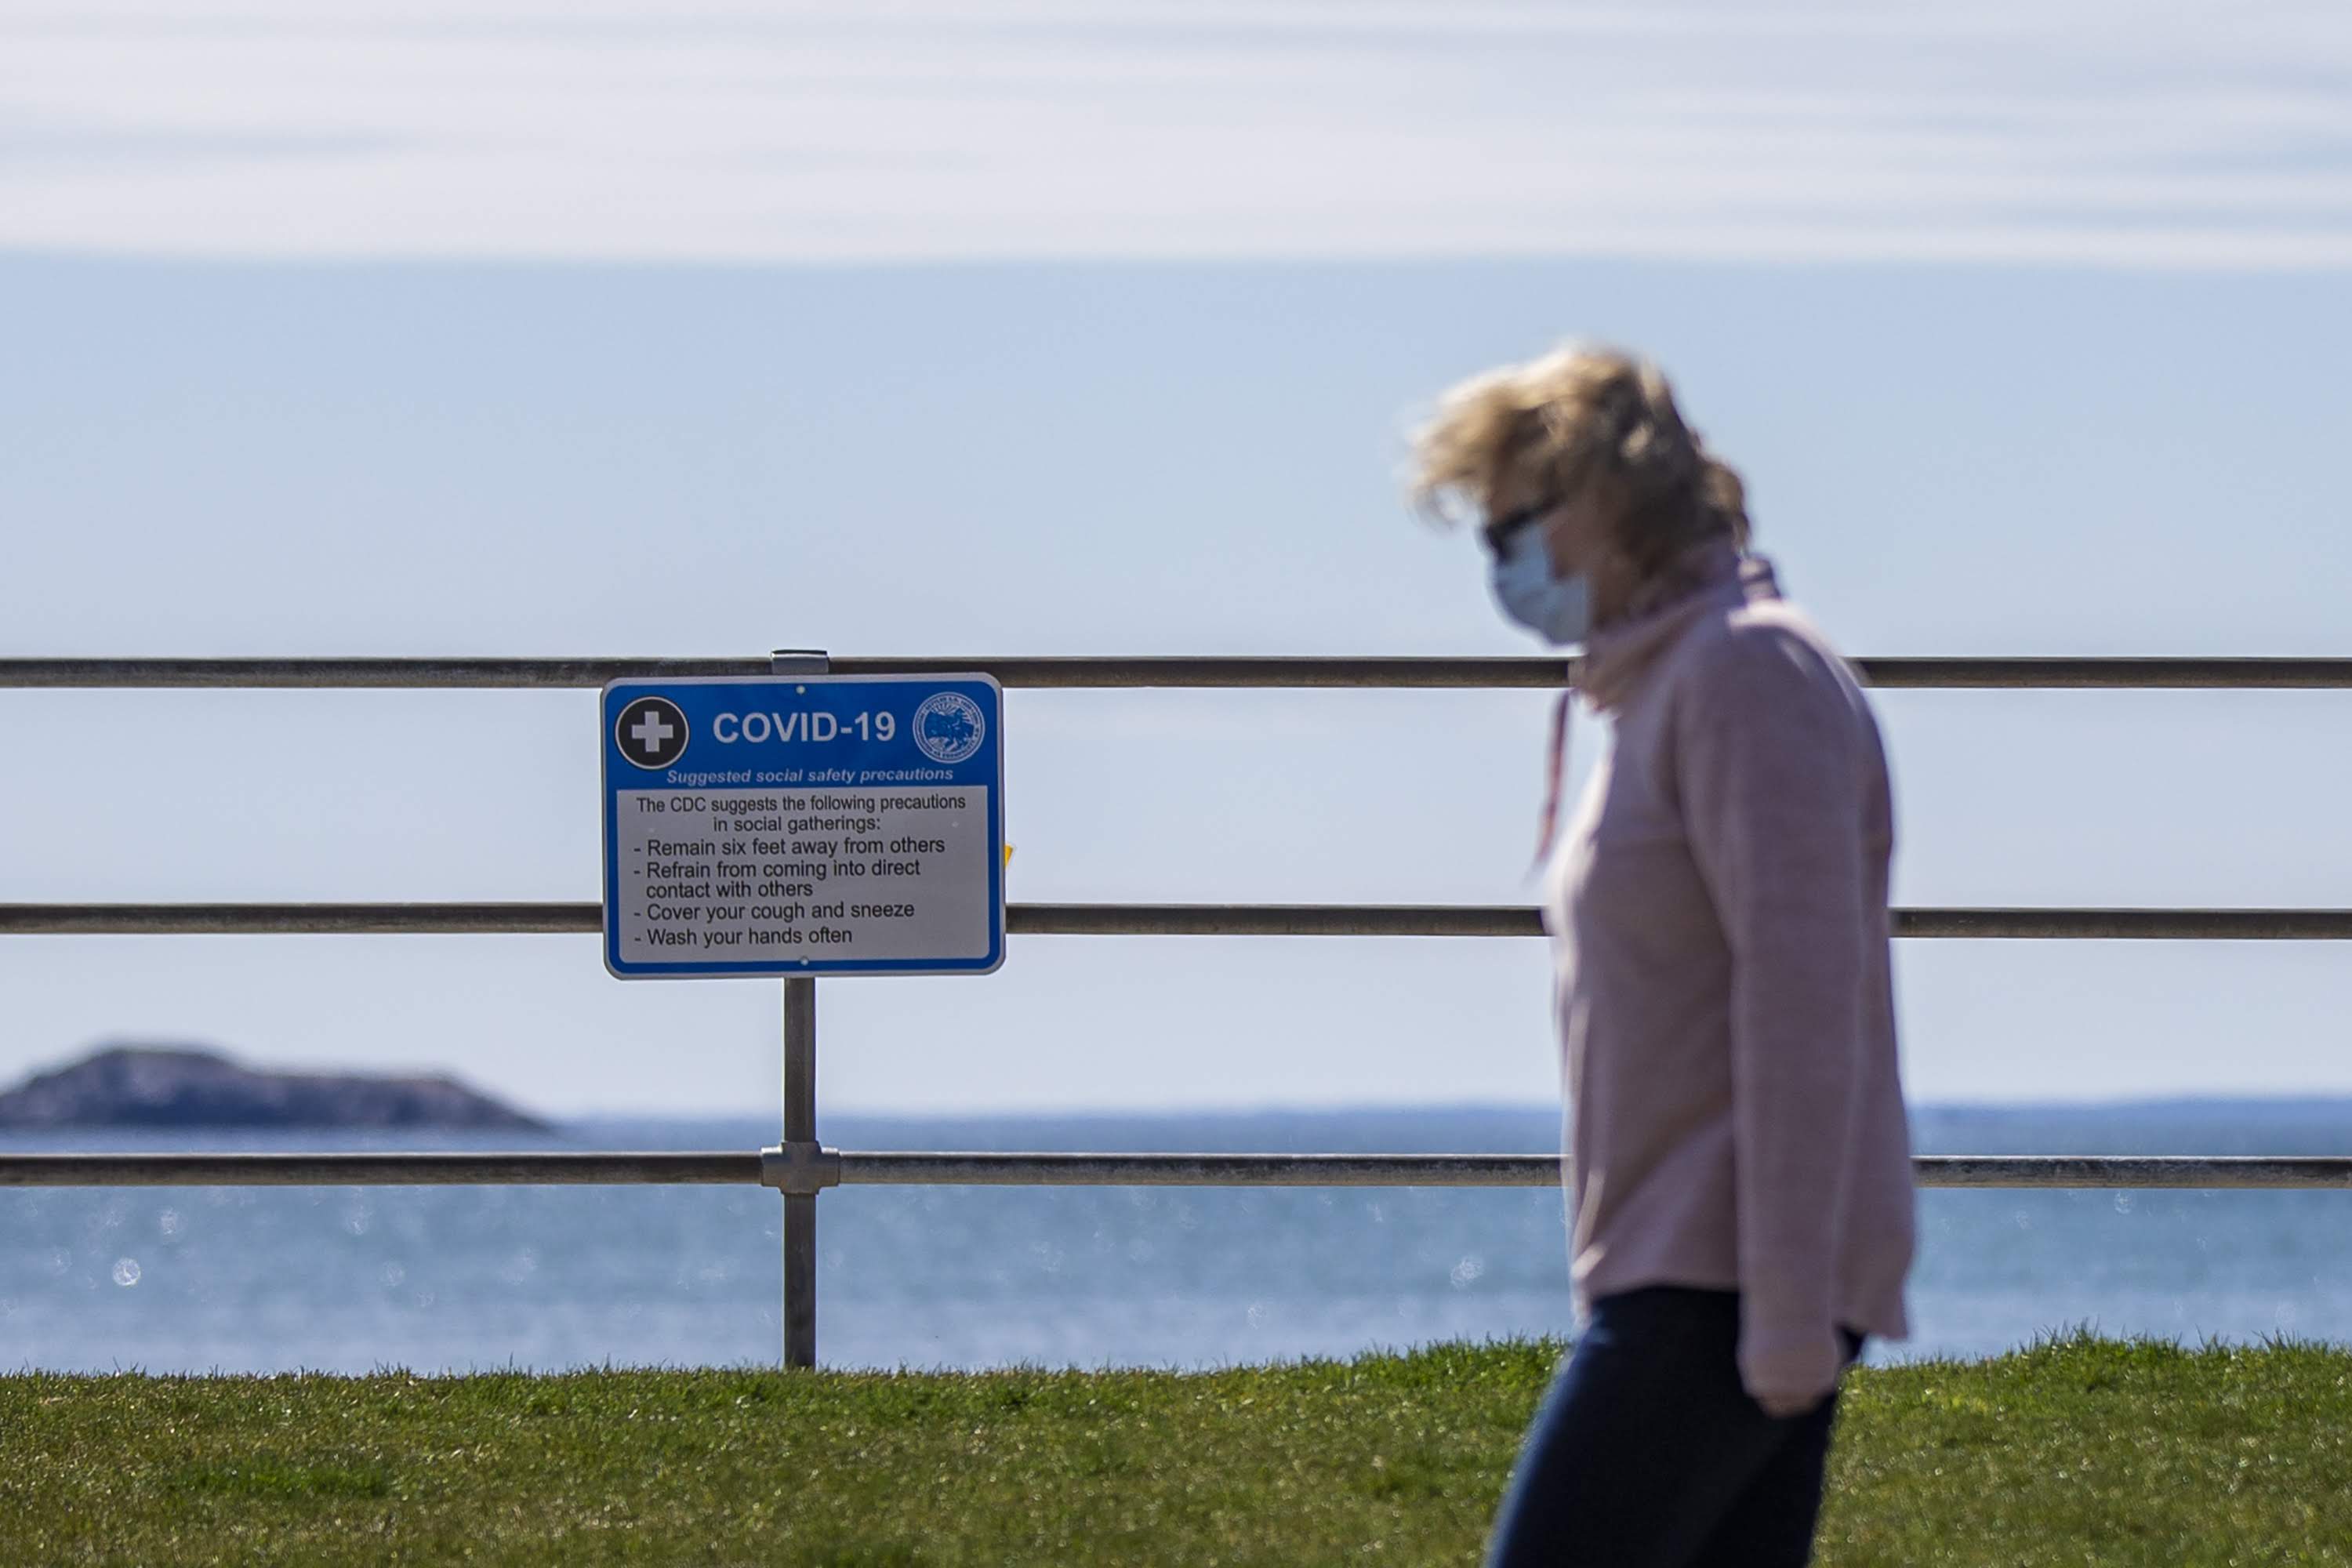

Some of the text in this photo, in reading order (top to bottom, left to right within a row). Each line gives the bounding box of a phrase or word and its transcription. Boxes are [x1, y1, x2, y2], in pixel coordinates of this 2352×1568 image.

[713, 712, 895, 742] COVID-19
[667, 768, 953, 786] Suggested social safety precautions
[637, 794, 965, 815] The CDC suggests the following precautions
[713, 815, 880, 834] in social gatherings:
[648, 839, 715, 856] Remain
[722, 838, 746, 855] six
[753, 837, 786, 855] feet
[792, 841, 837, 858] away
[844, 837, 883, 854] from
[891, 837, 945, 853] others
[648, 862, 710, 878] Refrain
[717, 861, 756, 877] from
[764, 860, 826, 880] coming
[834, 860, 865, 876] into
[872, 859, 920, 876] direct
[647, 880, 813, 898] contact with others
[648, 903, 700, 920] Cover
[706, 906, 745, 924] your
[751, 902, 804, 923] cough
[812, 902, 844, 918] and
[851, 905, 914, 917] sneeze
[648, 928, 696, 945] Wash
[704, 931, 742, 948] your
[750, 927, 802, 944] hands
[809, 926, 851, 943] often
